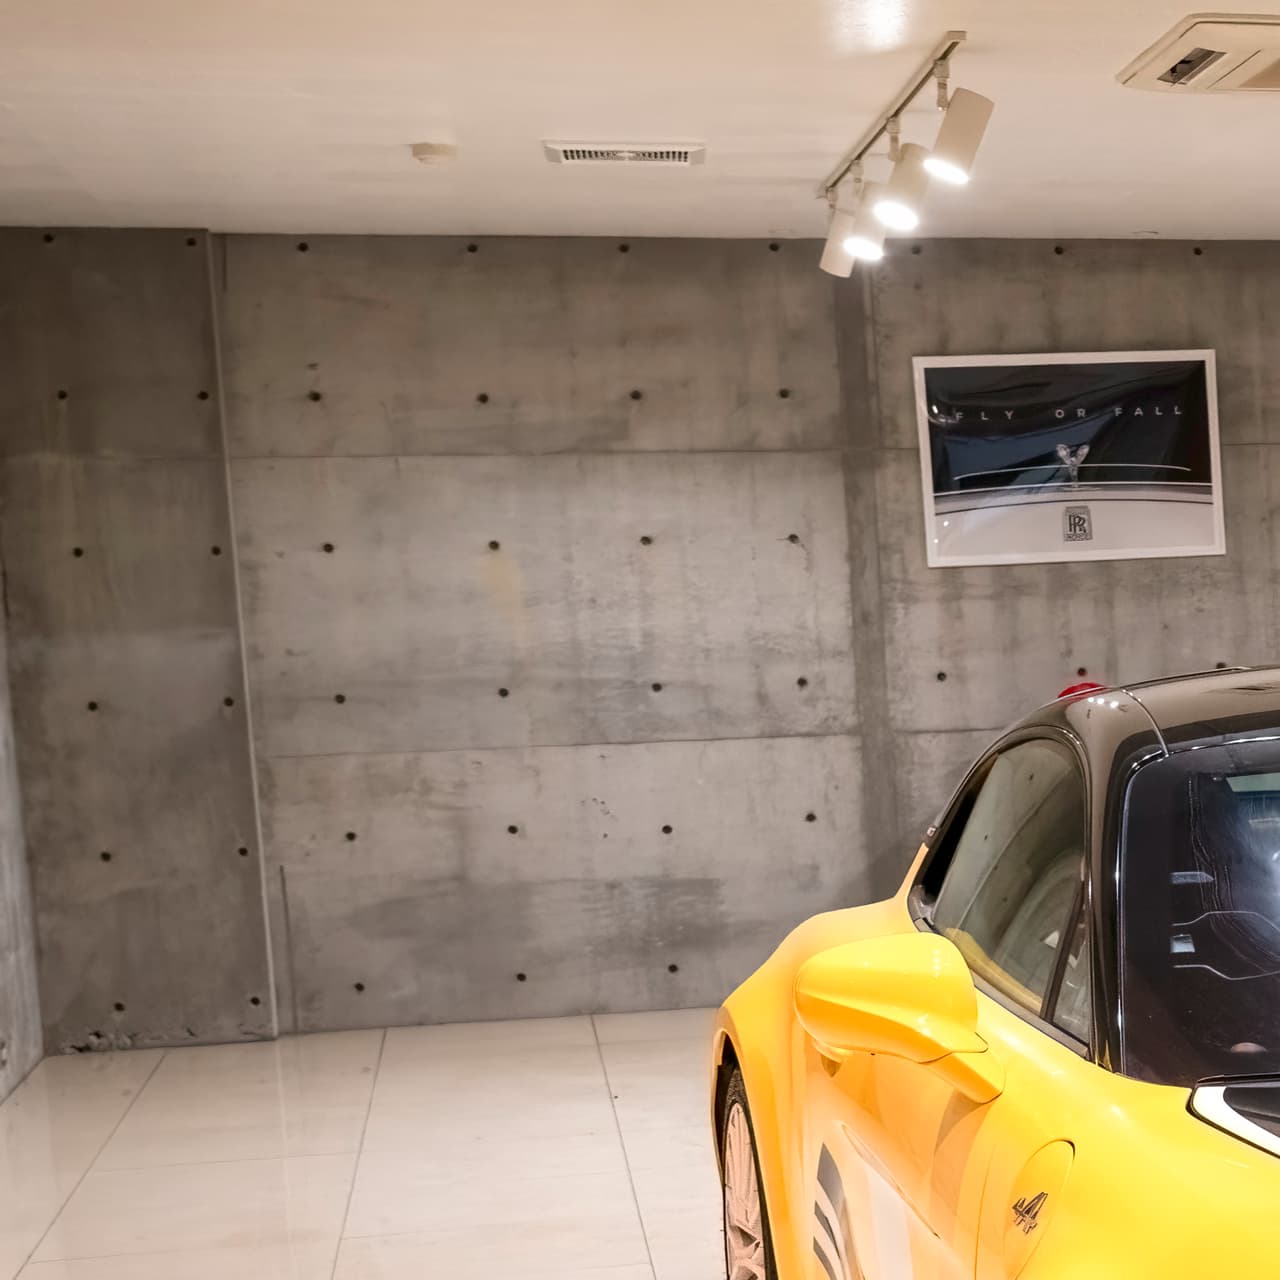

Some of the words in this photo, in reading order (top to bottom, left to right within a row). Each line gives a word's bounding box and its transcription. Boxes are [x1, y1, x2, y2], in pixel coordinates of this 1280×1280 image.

[955, 409, 1015, 422] FLY
[1055, 408, 1087, 419] OR
[1114, 405, 1183, 417] FALL
